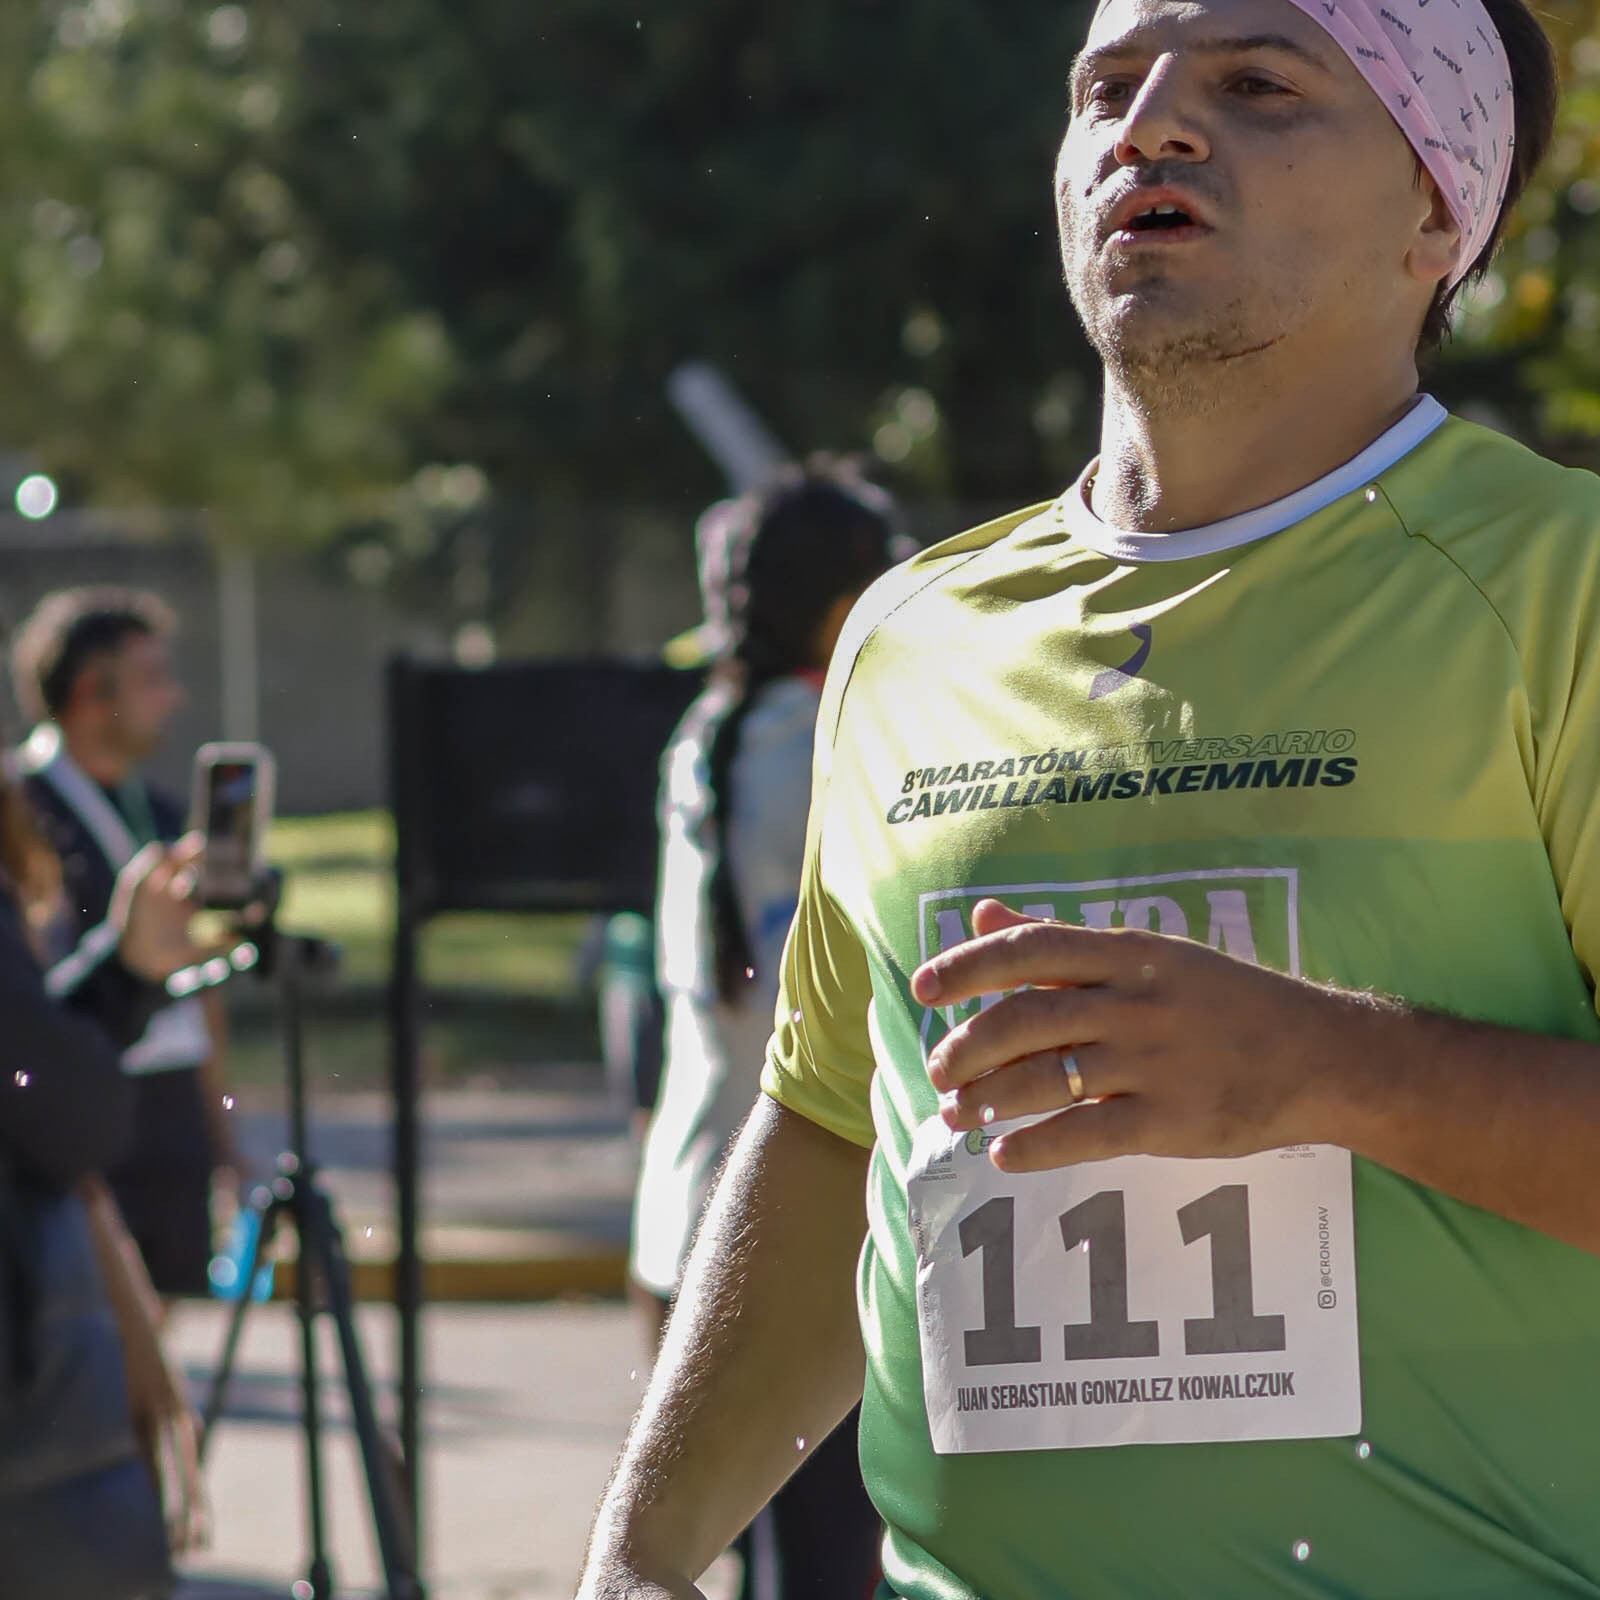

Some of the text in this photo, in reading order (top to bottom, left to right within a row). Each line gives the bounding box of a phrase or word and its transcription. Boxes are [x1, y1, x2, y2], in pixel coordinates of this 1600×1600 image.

[1432, 45, 1463, 75] MPRV
[957, 1183, 1287, 1367] 111
[1317, 1205, 1333, 1287] @CRONORAV
[957, 1371, 1296, 1412] JUAN SEBASTIAN GONZALEZ KOWALCZUK
